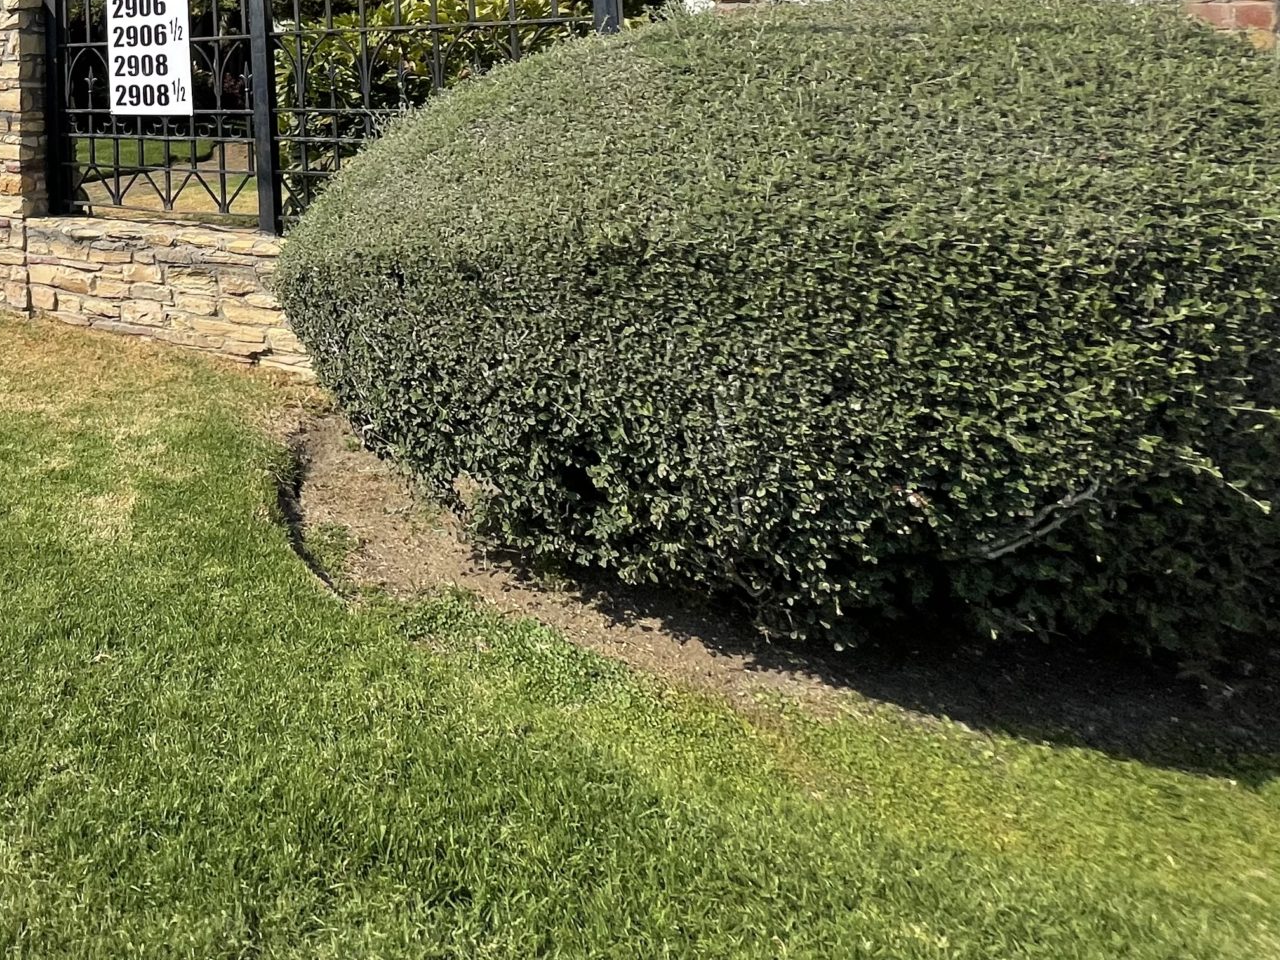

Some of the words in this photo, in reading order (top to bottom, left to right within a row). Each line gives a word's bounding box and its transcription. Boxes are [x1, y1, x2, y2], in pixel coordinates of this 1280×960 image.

[113, 24, 167, 47] 2906
[114, 54, 168, 77] 2908
[115, 84, 170, 106] 2908
